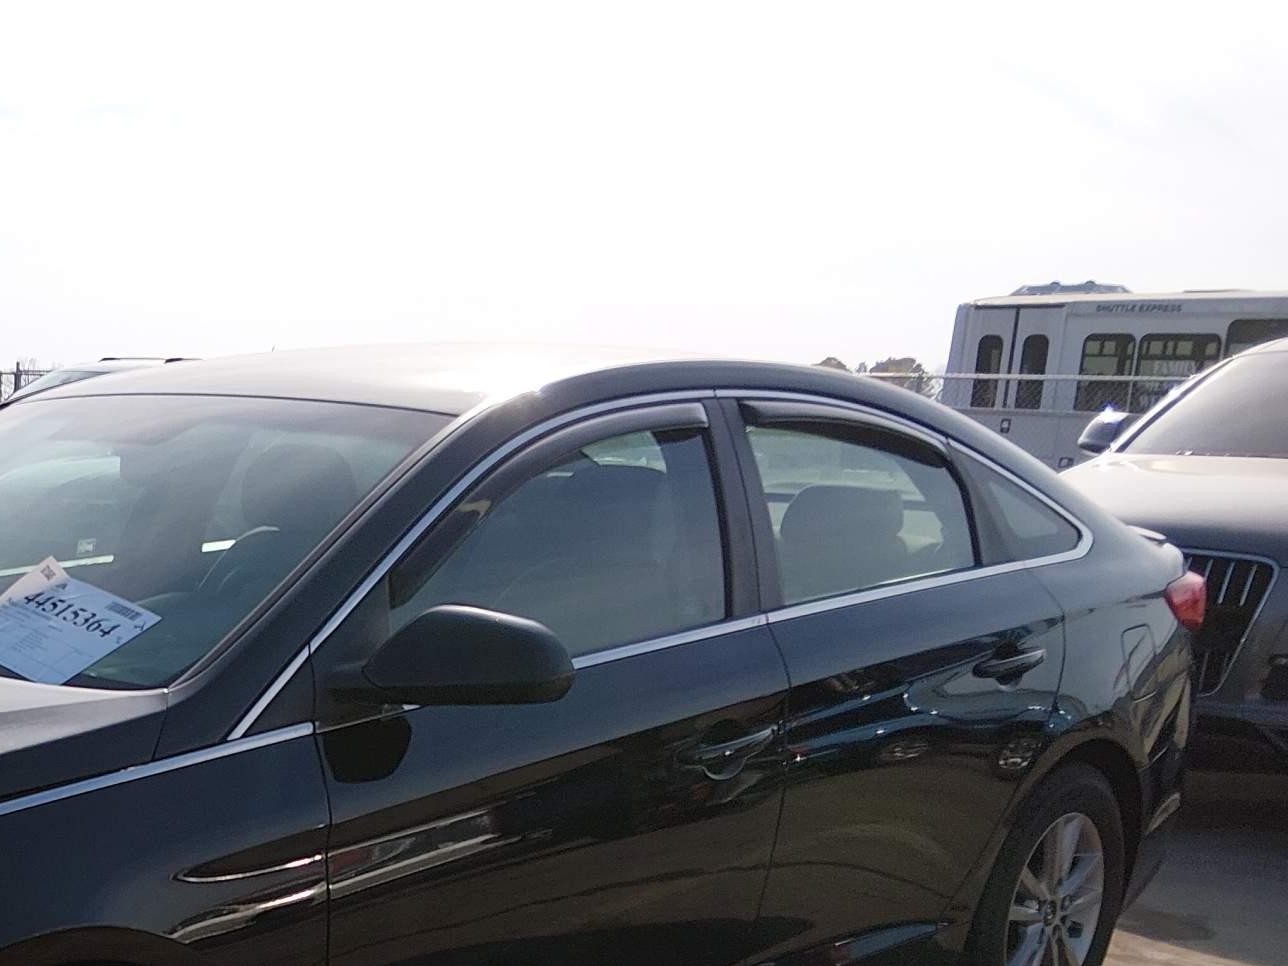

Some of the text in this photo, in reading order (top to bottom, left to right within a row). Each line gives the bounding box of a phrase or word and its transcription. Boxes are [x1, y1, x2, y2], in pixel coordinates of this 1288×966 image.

[1096, 303, 1182, 313] SHUTTLE EXPRESS
[24, 592, 121, 638] 44515364
